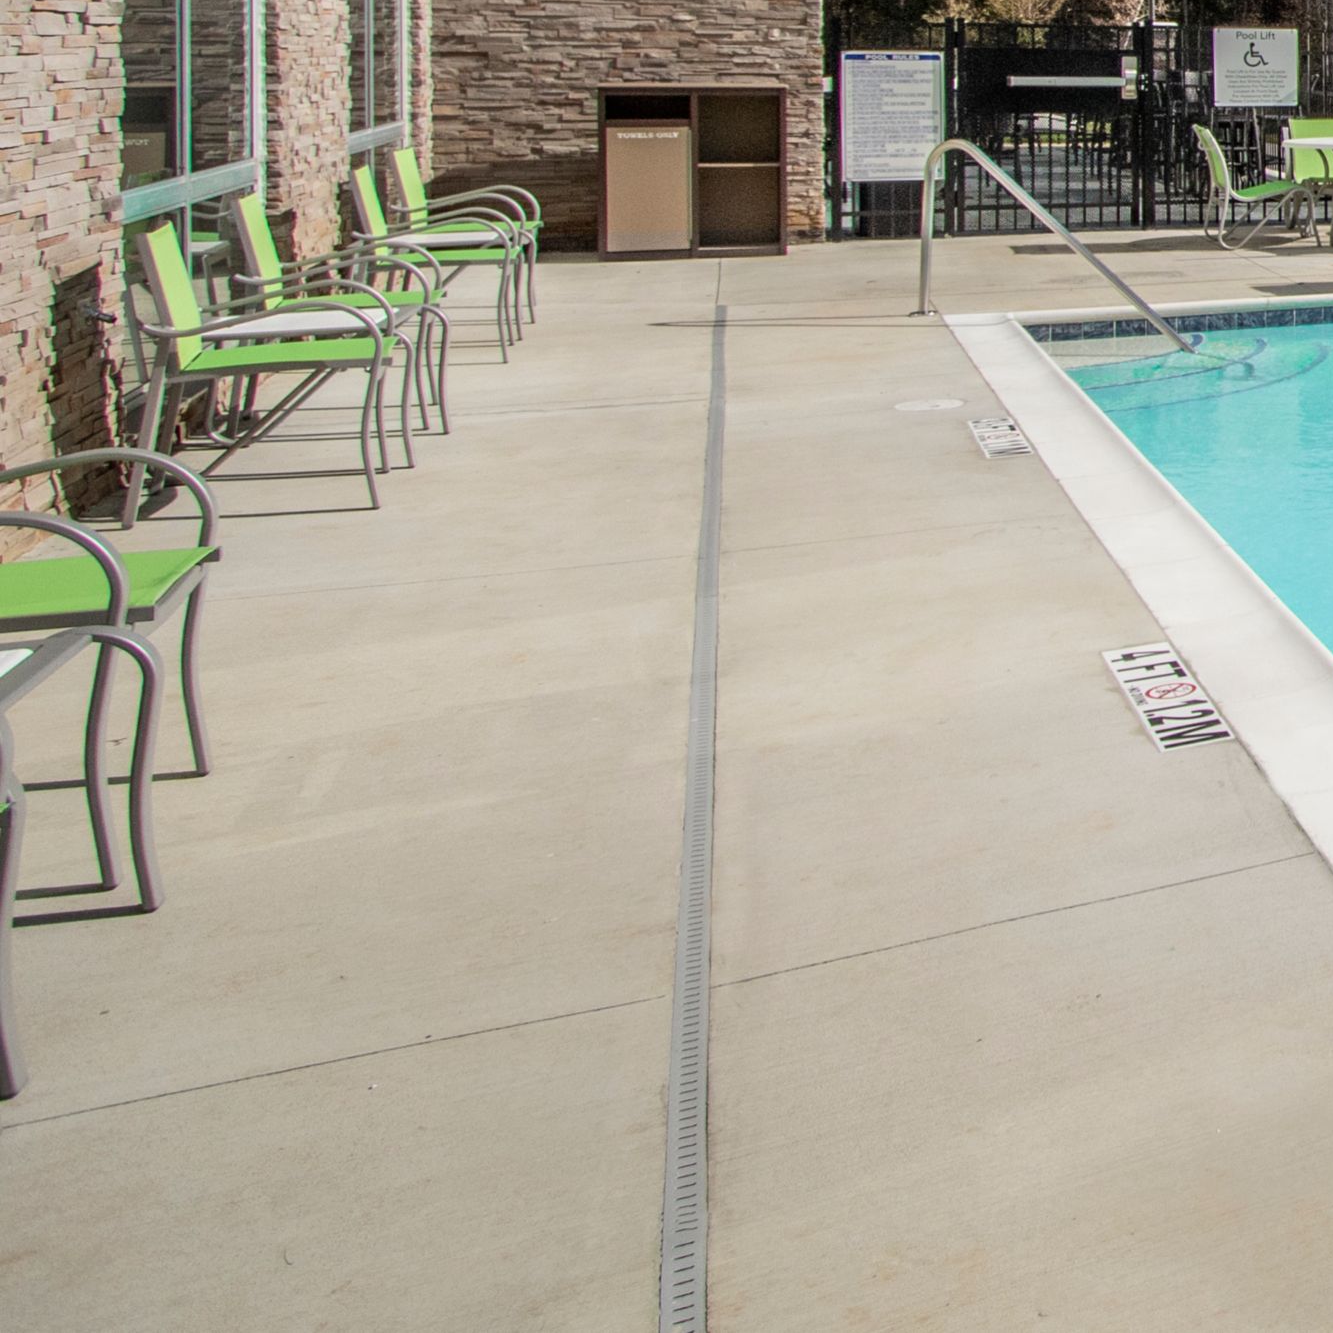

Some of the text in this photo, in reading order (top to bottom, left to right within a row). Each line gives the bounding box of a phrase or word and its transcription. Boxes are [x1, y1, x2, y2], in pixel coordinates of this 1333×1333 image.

[1236, 31, 1276, 40] Pool Lift
[1112, 650, 1170, 663] 4
[1117, 660, 1188, 683] FT
